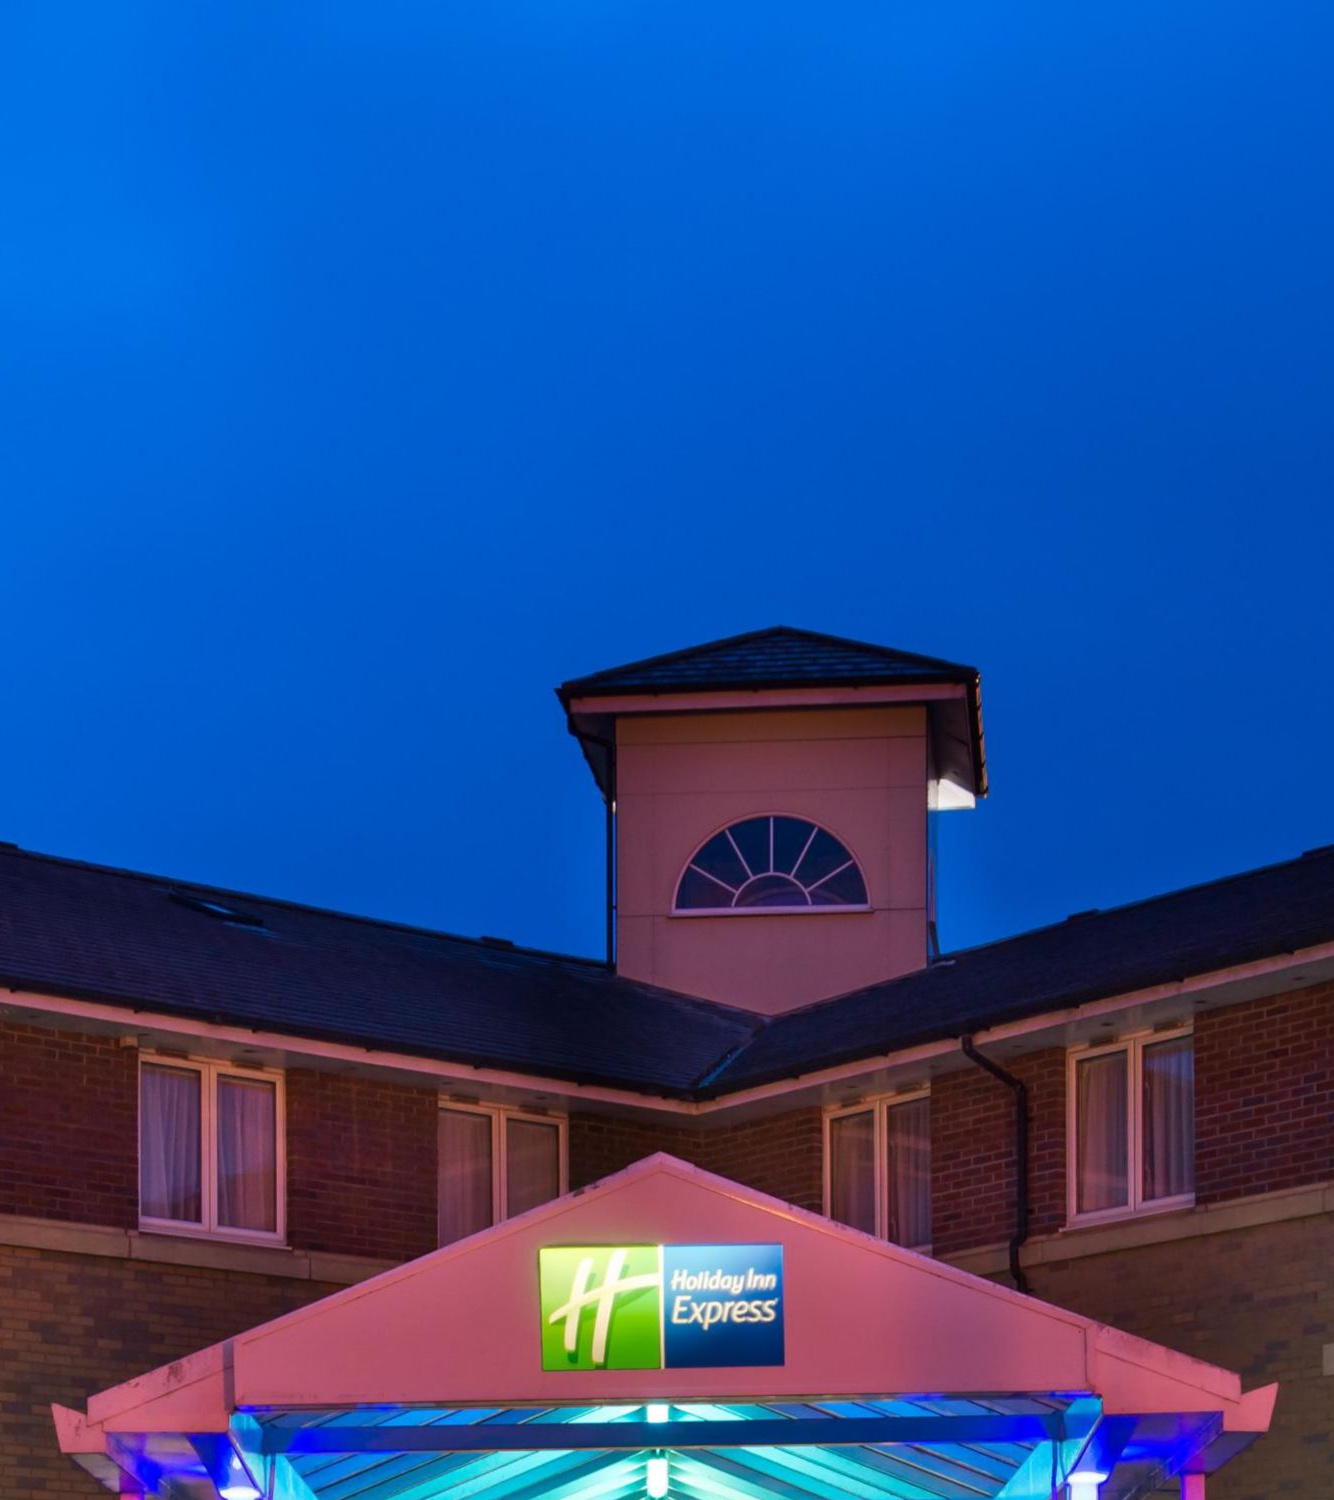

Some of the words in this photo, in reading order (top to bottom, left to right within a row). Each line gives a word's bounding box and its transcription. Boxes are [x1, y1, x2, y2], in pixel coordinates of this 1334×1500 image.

[670, 1268, 745, 1295] Holiday
[746, 1267, 780, 1291] Inn
[671, 1294, 780, 1331] Express
